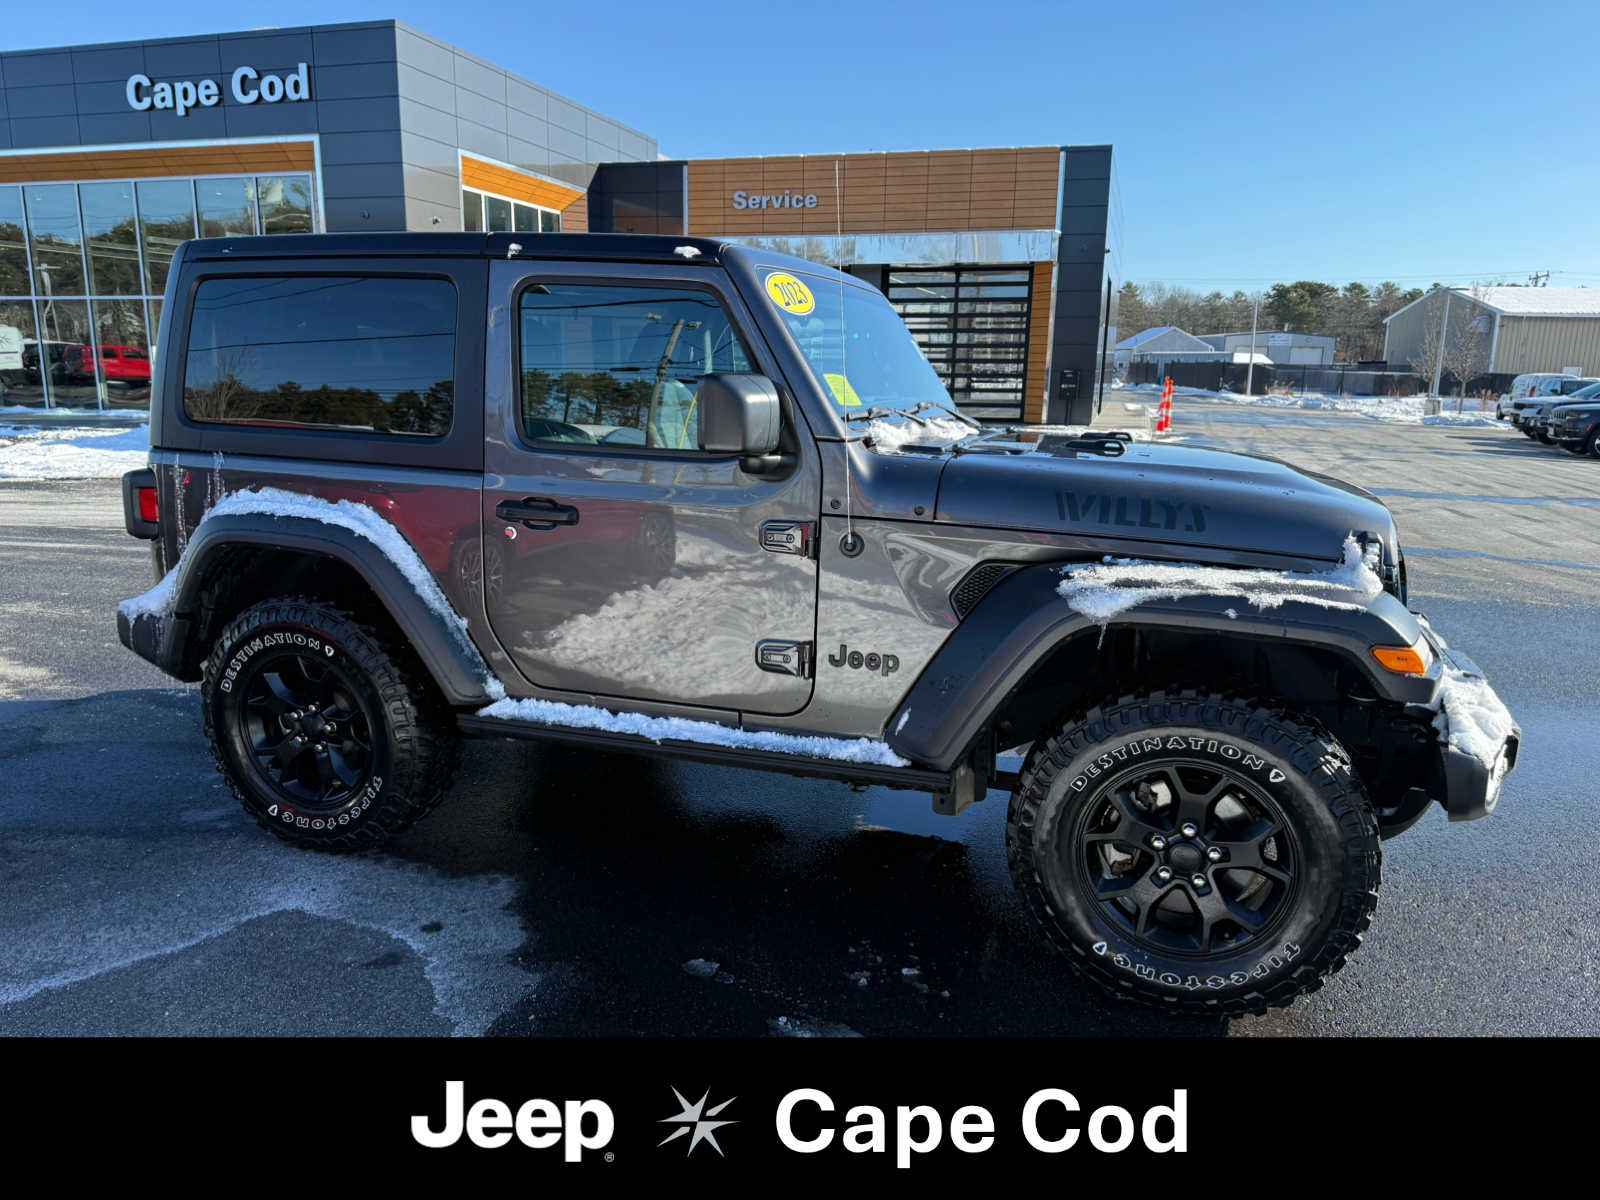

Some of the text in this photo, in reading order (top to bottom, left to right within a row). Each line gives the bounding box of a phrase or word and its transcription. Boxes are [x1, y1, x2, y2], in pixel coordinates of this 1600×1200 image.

[126, 62, 311, 117] Cape Cod
[732, 189, 819, 210] Service
[773, 281, 808, 307] 2023
[1055, 490, 1211, 533] WILLYS
[220, 632, 322, 694] DESTINATION
[828, 644, 900, 677] Jeep
[1070, 736, 1264, 792] DESTINATION
